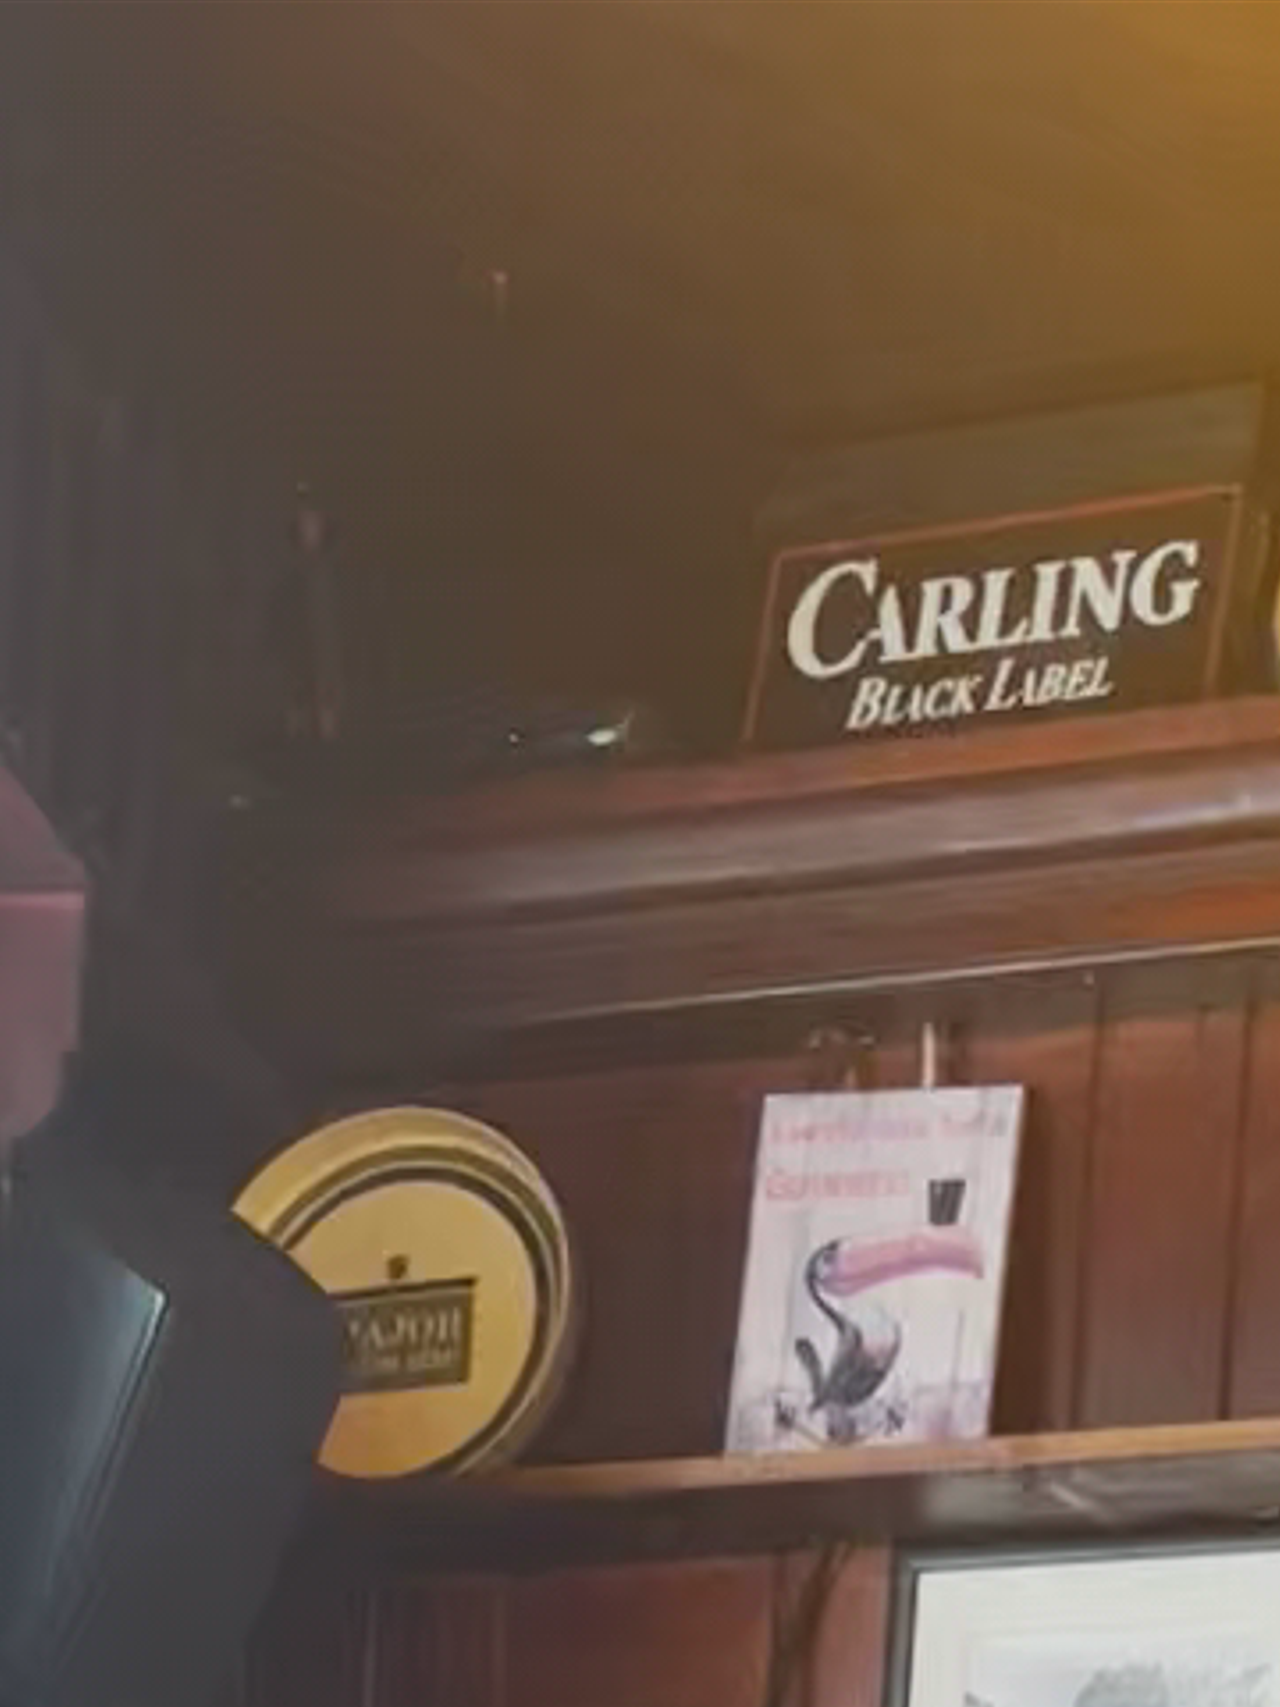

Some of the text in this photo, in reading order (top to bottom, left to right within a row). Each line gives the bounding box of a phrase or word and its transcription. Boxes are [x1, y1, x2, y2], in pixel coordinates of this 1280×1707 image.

[787, 540, 1200, 679] CARLING
[846, 656, 1115, 730] BLACK LABEL
